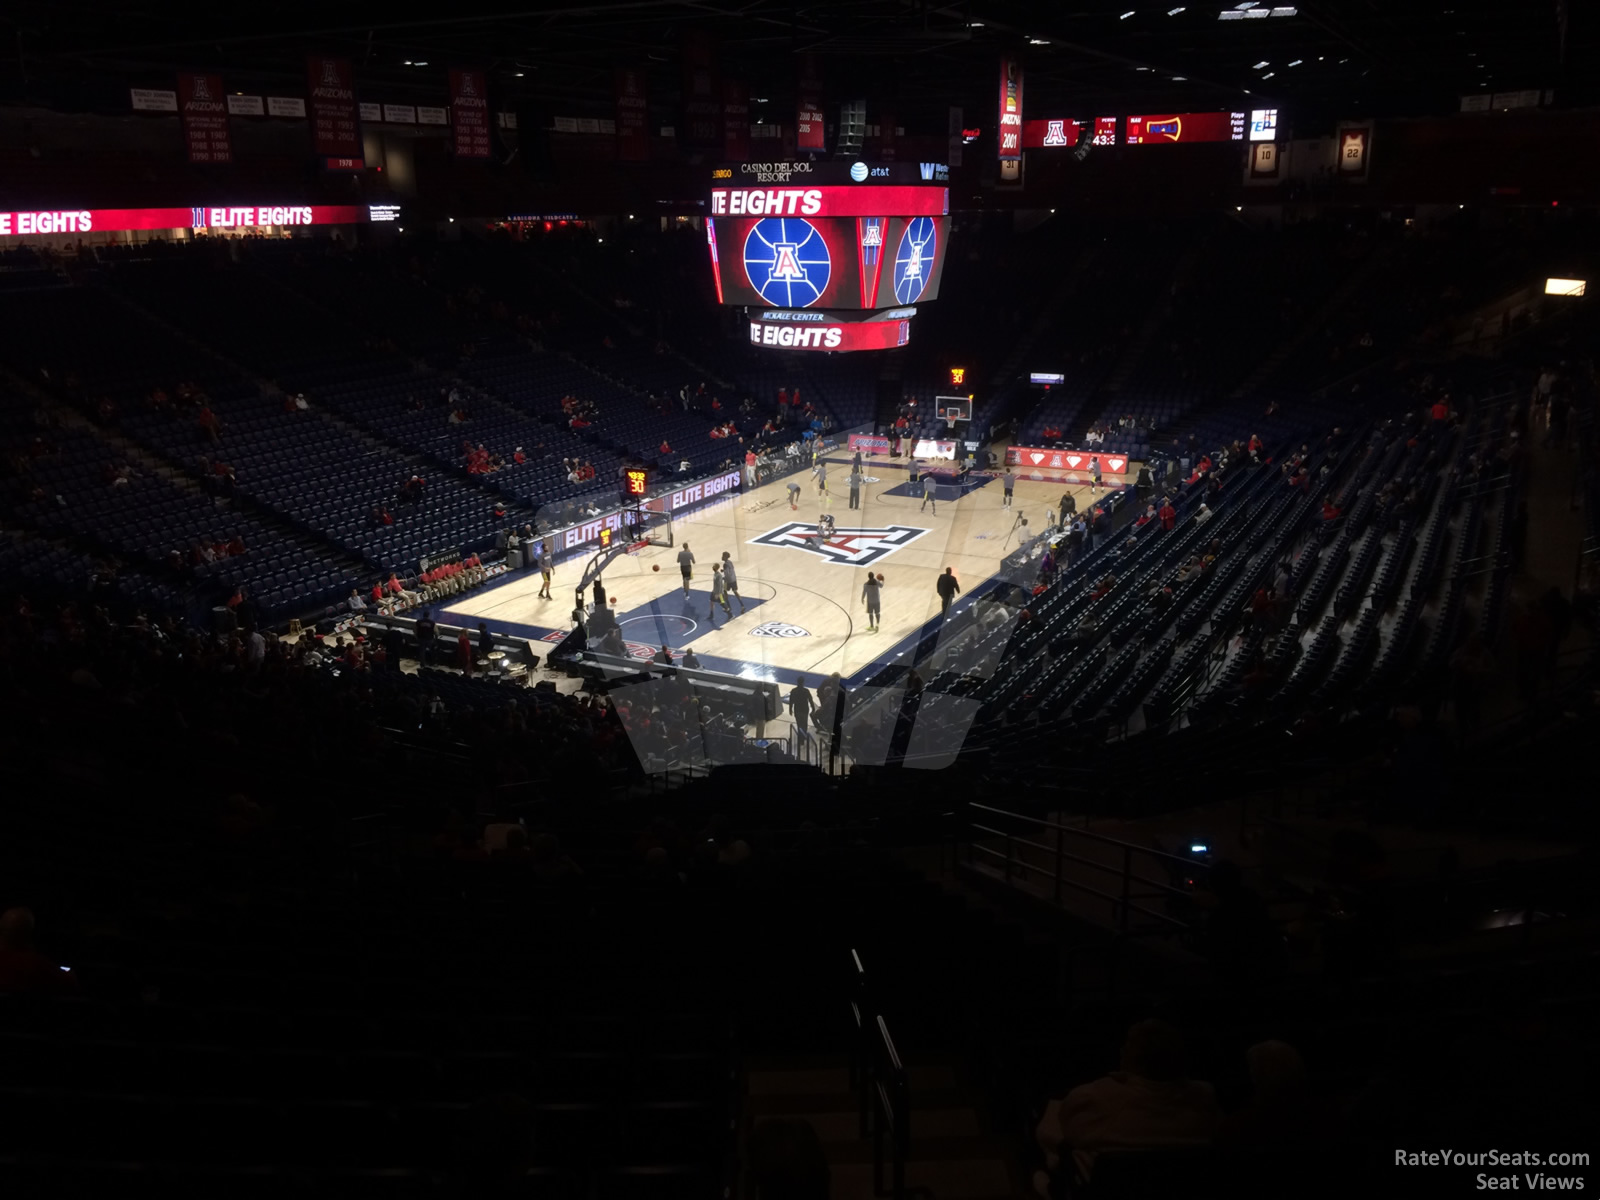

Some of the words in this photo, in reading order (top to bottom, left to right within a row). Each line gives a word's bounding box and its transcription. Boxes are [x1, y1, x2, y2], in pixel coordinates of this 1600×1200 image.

[313, 88, 352, 99] ARIZONA
[185, 101, 225, 111] ARIZONA
[455, 97, 487, 107] ARIZONA
[1003, 133, 1017, 148] 2001
[1262, 151, 1271, 160] 10
[1347, 149, 1358, 157] 22
[741, 163, 773, 173] CASINO
[774, 163, 792, 172] DEL
[793, 162, 813, 172] SOL
[870, 167, 890, 177] at&t
[757, 173, 792, 182] RESORT
[729, 189, 823, 215] EIGHTS
[17, 210, 92, 233] EIGHTS
[210, 208, 255, 228] ELITE
[257, 206, 313, 226] EIGHTS
[792, 313, 824, 321] CENTER
[763, 325, 842, 347] EIGHTS
[953, 374, 963, 383] 30
[631, 480, 644, 492] 30
[673, 485, 702, 509] ELITE
[704, 471, 741, 498] EIGHTS
[429, 552, 461, 566] NETWORKS
